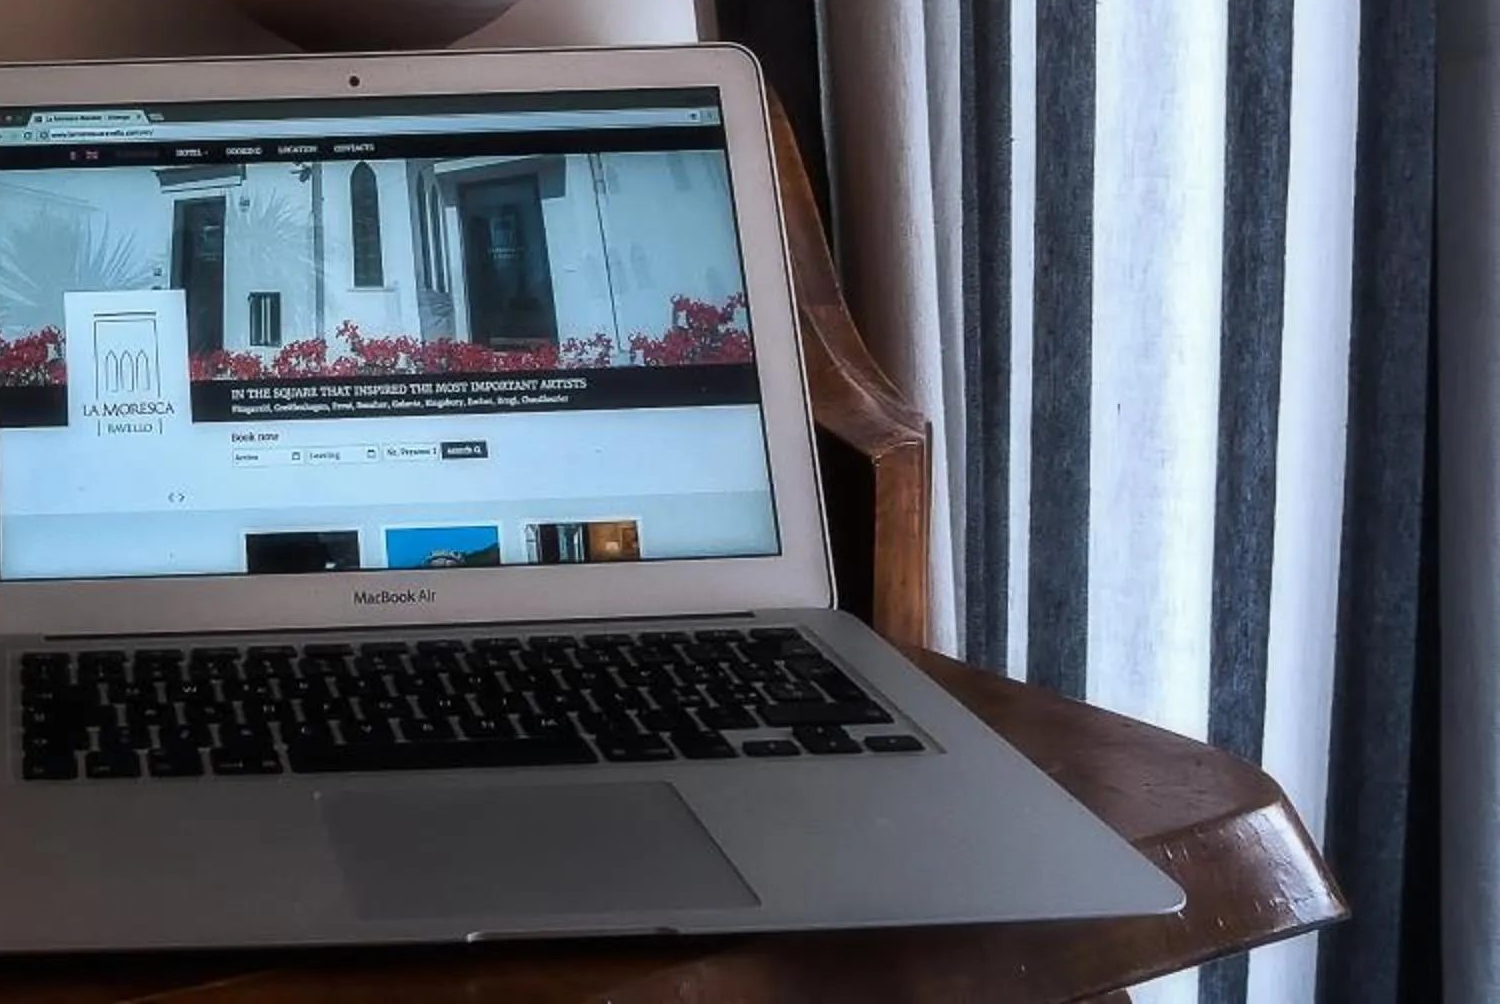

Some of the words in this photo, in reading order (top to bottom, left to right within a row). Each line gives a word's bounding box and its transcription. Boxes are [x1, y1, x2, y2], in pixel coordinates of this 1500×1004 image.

[231, 389, 245, 400] IN
[246, 388, 271, 399] THE
[273, 387, 319, 400] SQUARE
[320, 385, 352, 397] THAT
[353, 384, 407, 396] INSPIRED
[411, 383, 434, 395] THE
[436, 382, 469, 393] MOST
[470, 380, 540, 393] IMPORTANT
[540, 377, 588, 390] ARTISTS
[82, 404, 100, 417] LA
[102, 401, 176, 417] MORESCA
[107, 423, 154, 434] RAVELLO
[231, 432, 256, 443] Book
[258, 432, 280, 442] now
[353, 588, 416, 605] MacBook
[419, 587, 437, 602] Air
